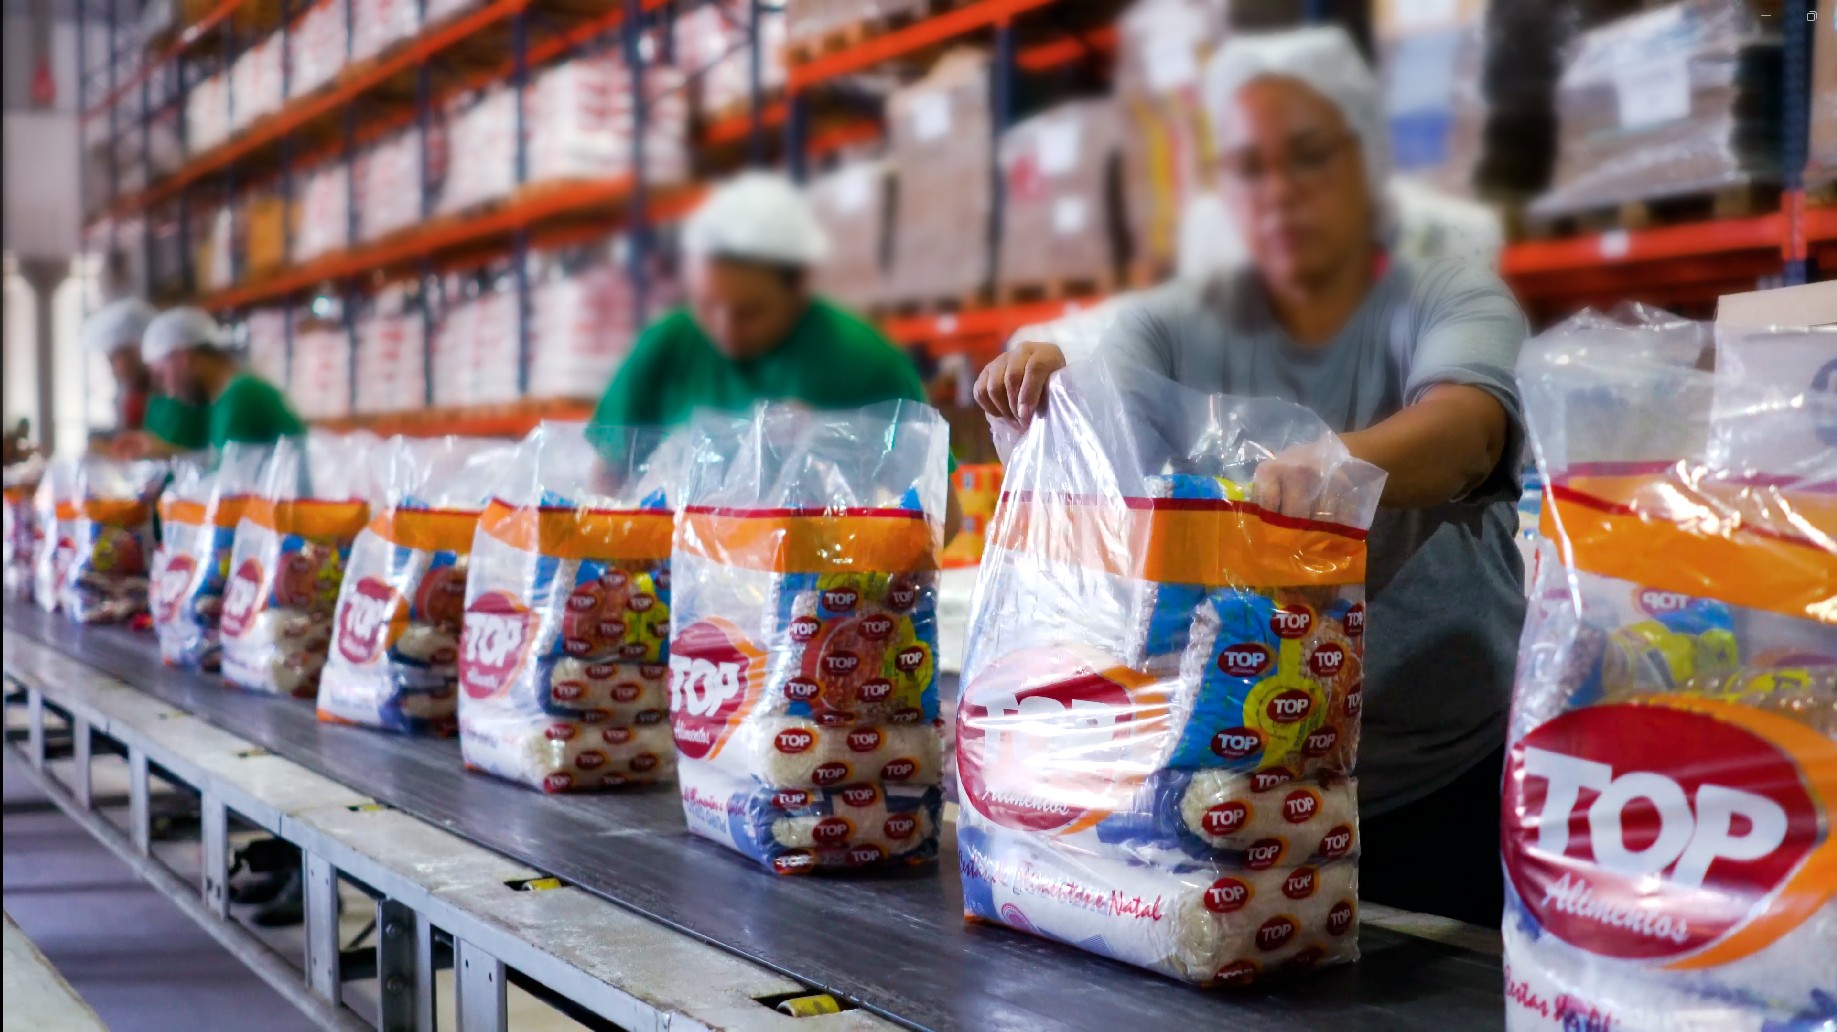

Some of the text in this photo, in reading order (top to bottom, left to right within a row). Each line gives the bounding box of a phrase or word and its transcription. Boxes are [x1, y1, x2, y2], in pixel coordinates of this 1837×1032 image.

[825, 592, 856, 604] TOP
[892, 590, 913, 602] TOP
[862, 621, 891, 632] TOP
[1275, 612, 1310, 629] TOP
[791, 623, 818, 635] TOP
[464, 613, 523, 668] TOP
[827, 656, 857, 668] TOP
[900, 652, 923, 664] TOP
[1223, 651, 1266, 667] TOP
[1314, 650, 1342, 667] TOP
[669, 653, 741, 717] TOP
[789, 683, 817, 696] TOP
[861, 684, 890, 696] TOP
[1273, 698, 1309, 714] TOP
[780, 734, 811, 746] TOP
[851, 733, 878, 745] TOP
[1217, 733, 1259, 750] TOP
[1308, 733, 1336, 749] TOP
[817, 767, 846, 779] TOP
[886, 764, 913, 776] TOP
[845, 789, 873, 801] TOP
[1287, 796, 1315, 815] TOP
[1209, 809, 1245, 826] TOP
[1523, 745, 1788, 889] TOP
[818, 824, 847, 836] TOP
[888, 820, 914, 832] TOP
[1324, 832, 1350, 851] TOP
[852, 850, 880, 862] TOP
[1248, 845, 1280, 861] TOP
[1288, 874, 1312, 891] TOP
[1209, 885, 1245, 904] TOP
[1107, 889, 1163, 921] Natal
[1542, 873, 1690, 943] Alimentos
[1330, 908, 1350, 927] TOP
[1262, 923, 1292, 942] TOP
